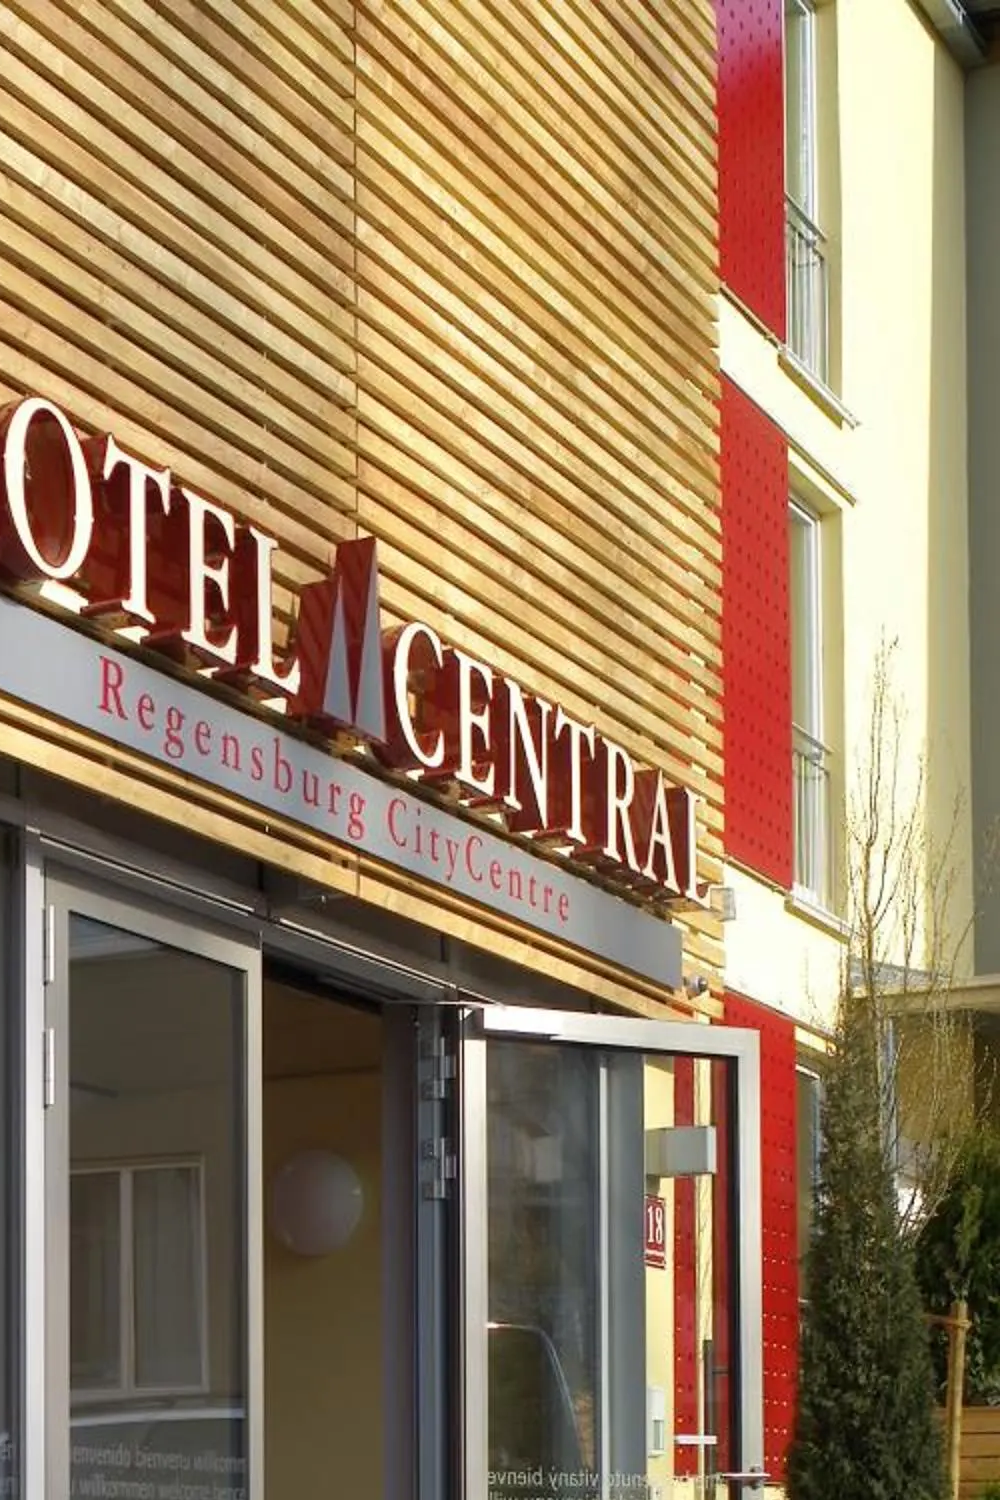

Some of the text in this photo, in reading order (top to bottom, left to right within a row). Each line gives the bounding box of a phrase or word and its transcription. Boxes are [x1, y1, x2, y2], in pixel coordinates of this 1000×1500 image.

[98, 655, 570, 923] Regensburg CityCentre
[394, 621, 712, 911] CENTRAL
[647, 1205, 663, 1245] 18
